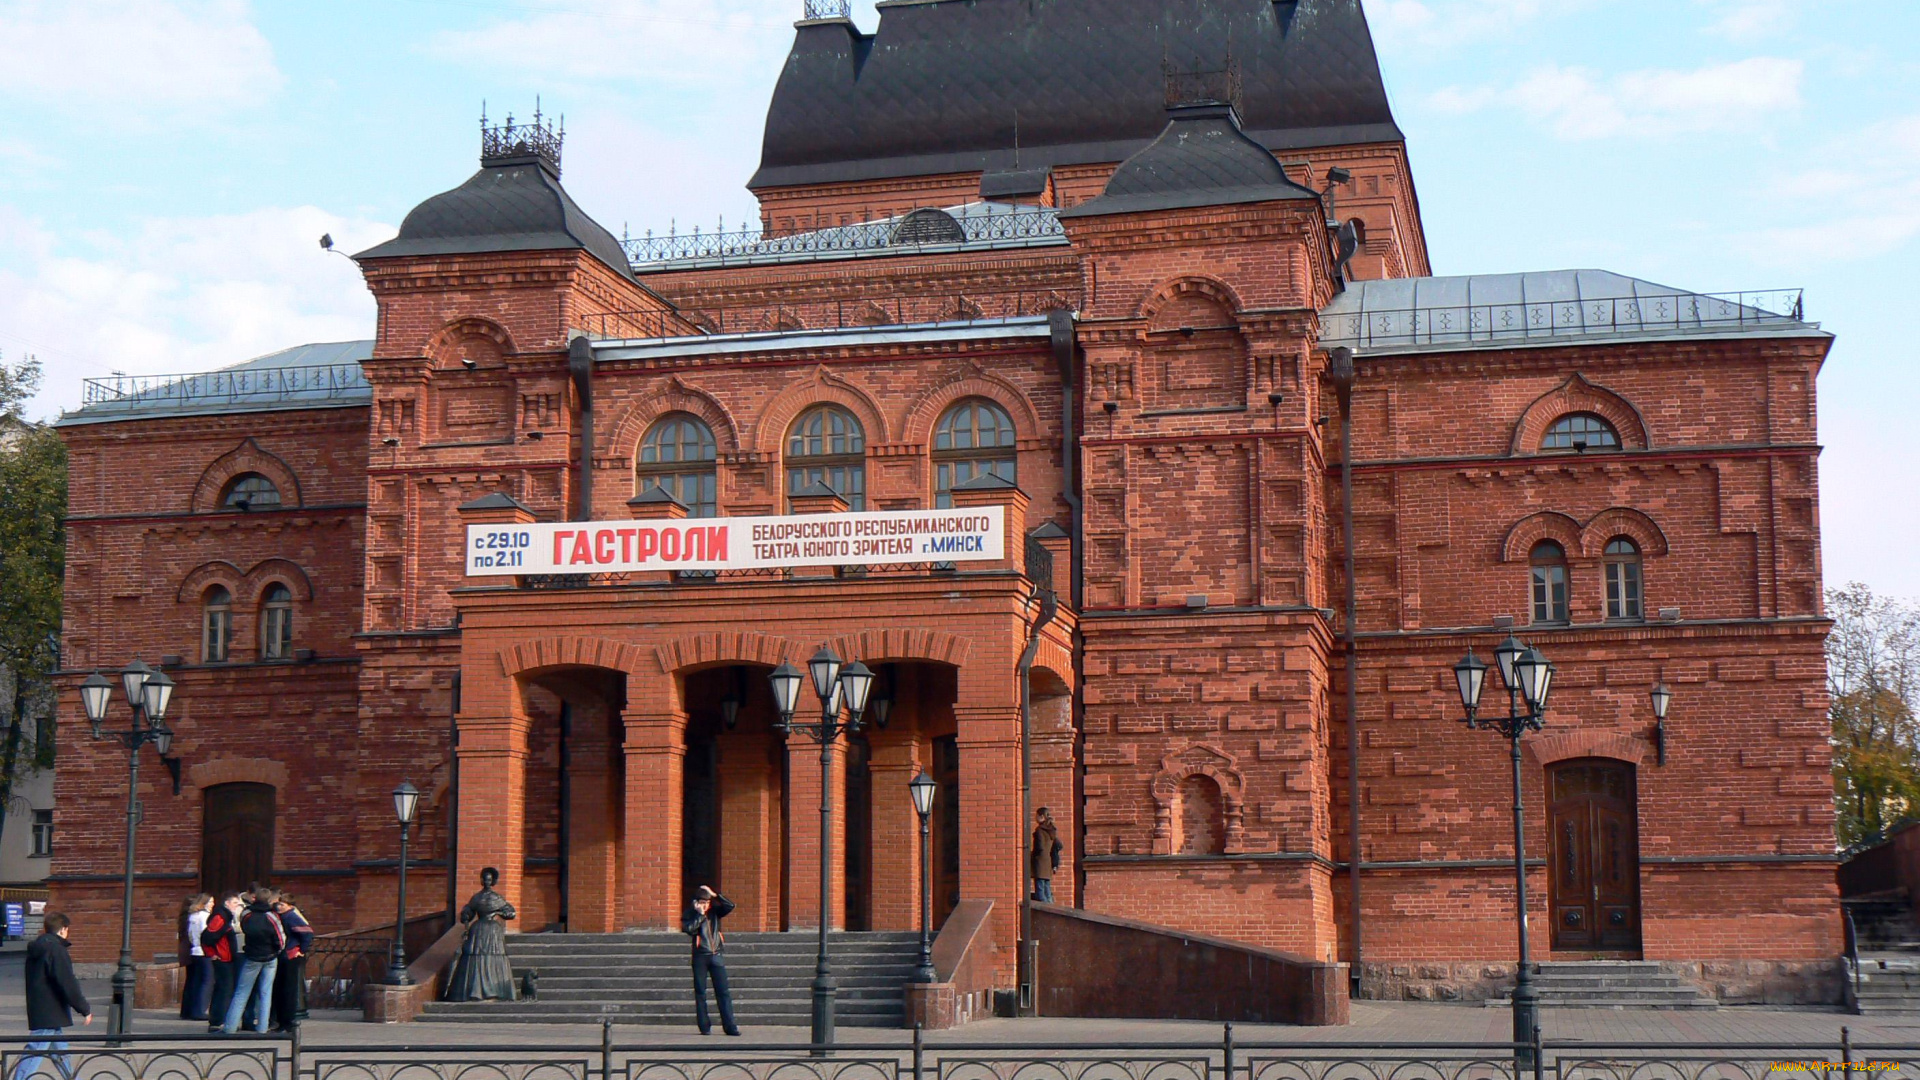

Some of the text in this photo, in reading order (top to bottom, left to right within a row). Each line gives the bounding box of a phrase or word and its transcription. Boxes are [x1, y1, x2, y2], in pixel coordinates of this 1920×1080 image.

[475, 532, 530, 549] с 29.10
[752, 517, 990, 541] БЕЛОРУССКОГО РЕСПУБЛИКАНСКОГО
[552, 526, 728, 565] ГАСТРОЛИ
[752, 537, 913, 560] ТЕАТРА ЮНОГО ЗРИТЕЛЯ
[474, 550, 523, 568] по 2.11
